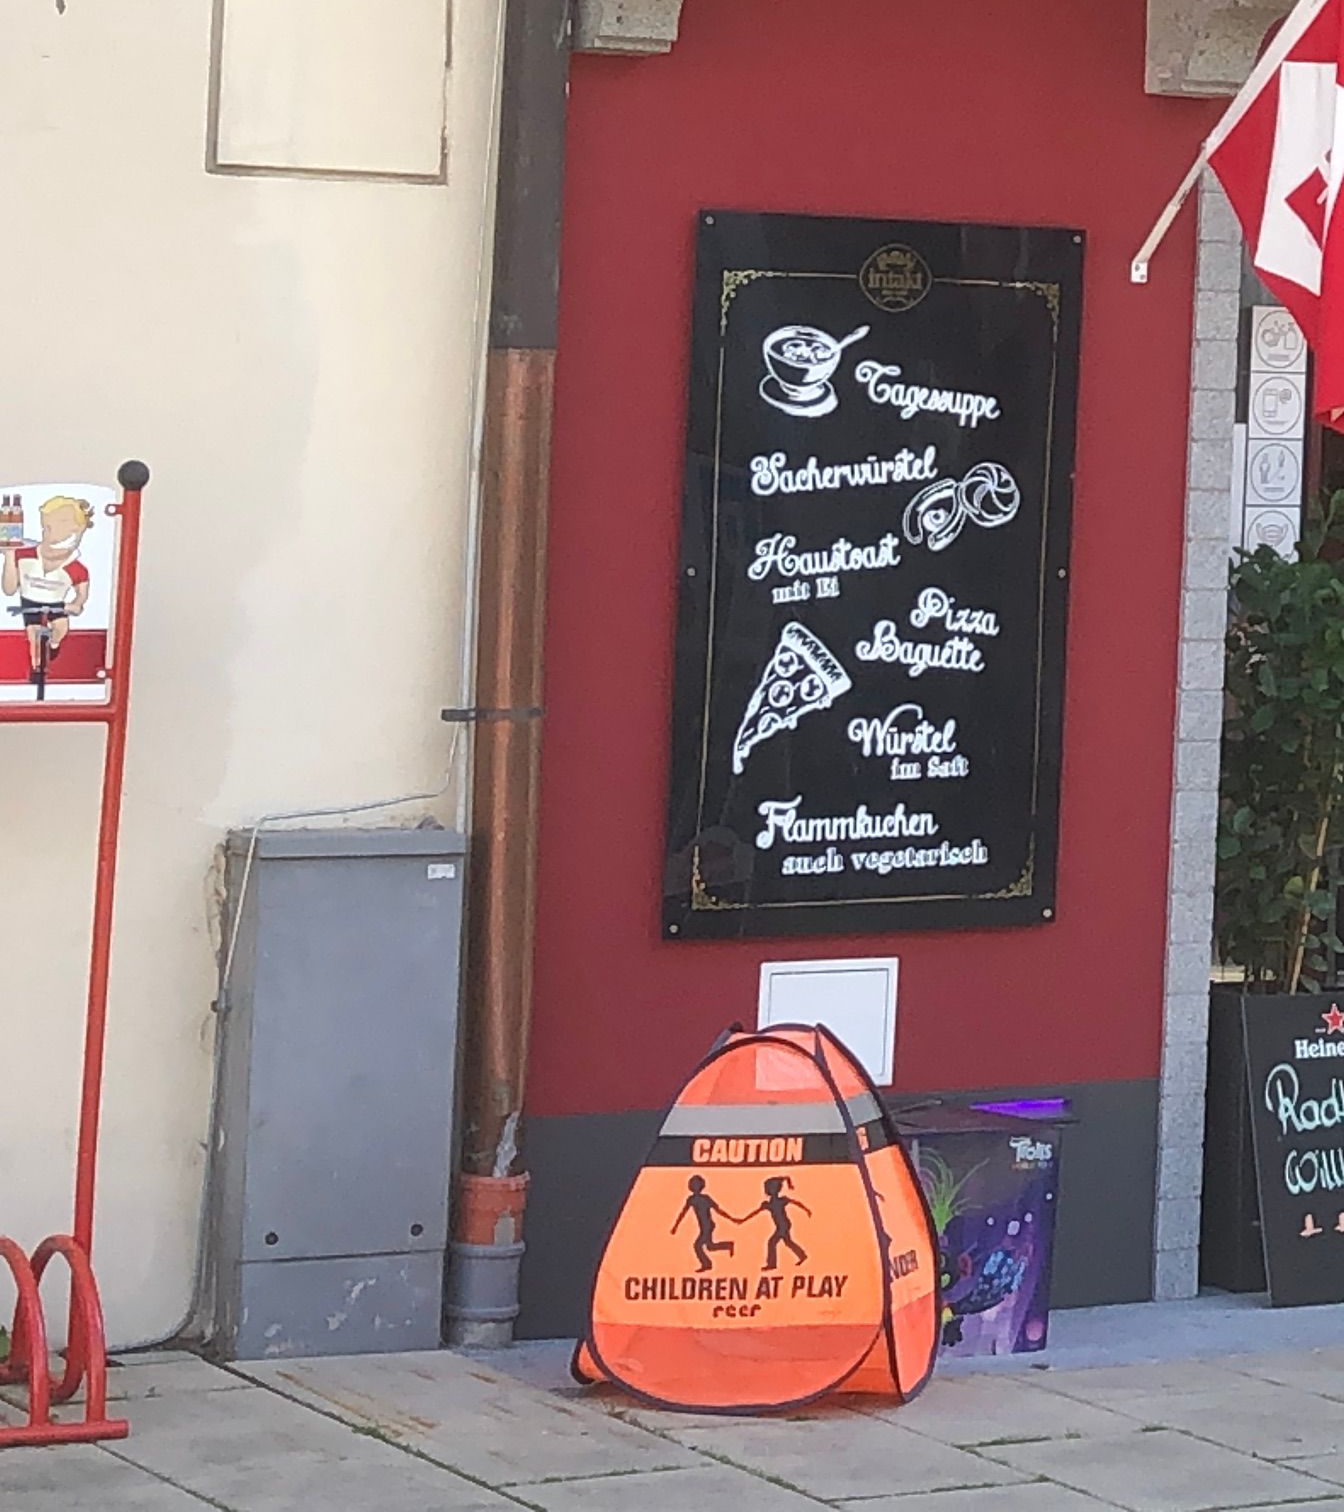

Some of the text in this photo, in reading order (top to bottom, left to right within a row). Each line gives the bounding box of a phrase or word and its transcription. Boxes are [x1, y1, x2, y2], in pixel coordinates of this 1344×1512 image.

[855, 360, 1001, 428] Tagessuppe
[750, 445, 937, 496] Sacherwürstel
[746, 533, 901, 581] Haustoast
[772, 577, 840, 604] mit Ei
[910, 587, 1001, 636] Pizza
[855, 619, 986, 678] Baguette
[847, 702, 957, 758] Würstel
[890, 755, 970, 781] im Saft
[755, 795, 938, 849] Flammkuchen
[782, 839, 989, 875] auch vegetarisch
[692, 1137, 804, 1164] CAUTION
[624, 1274, 849, 1301] CHILDREN AT PLAY
